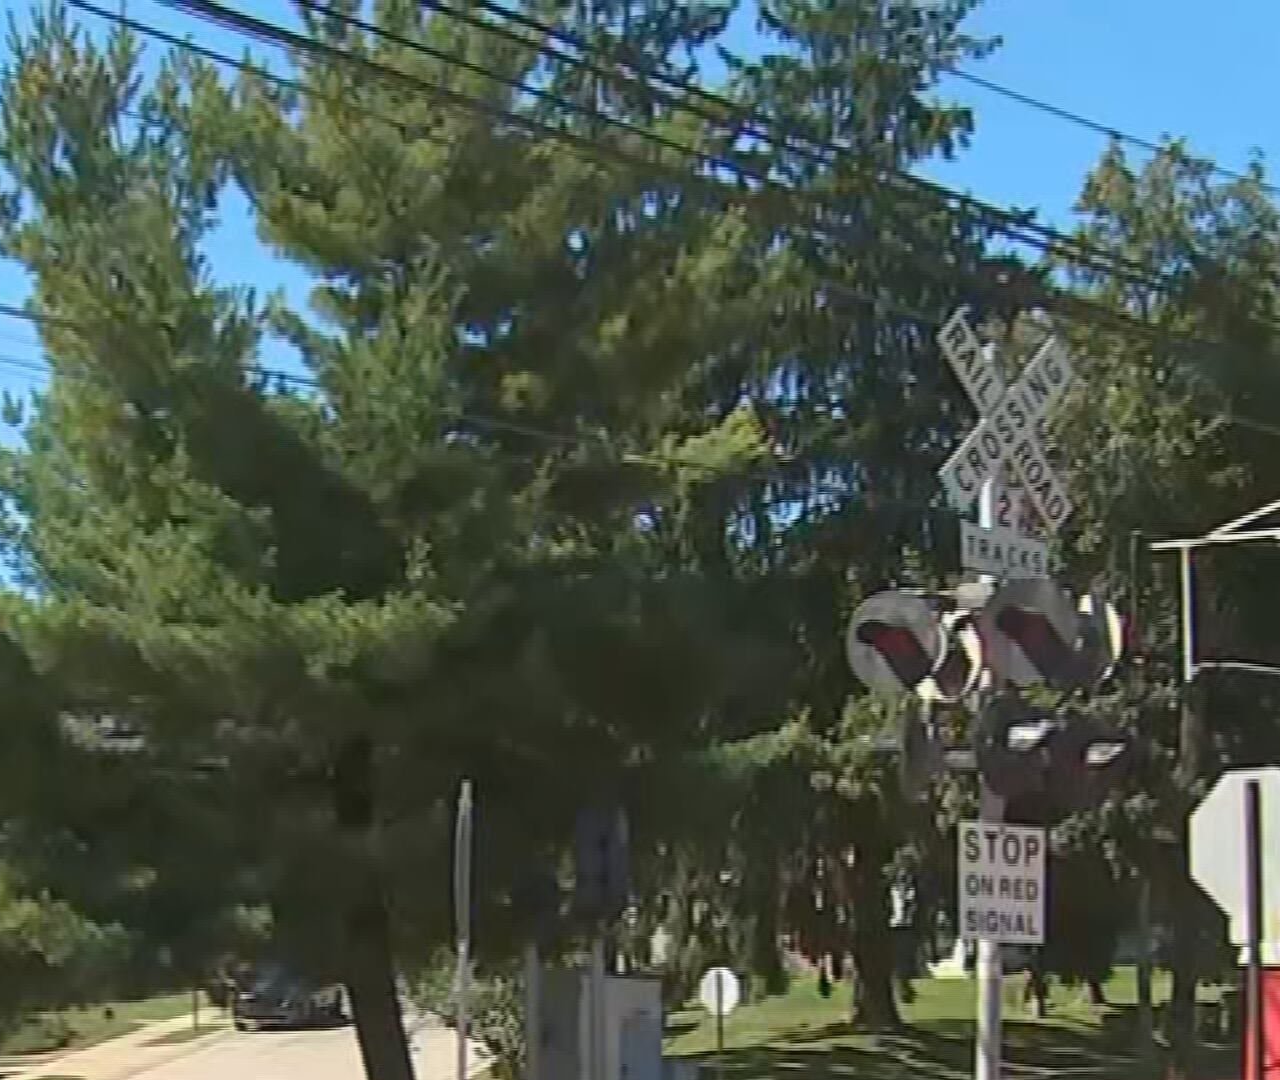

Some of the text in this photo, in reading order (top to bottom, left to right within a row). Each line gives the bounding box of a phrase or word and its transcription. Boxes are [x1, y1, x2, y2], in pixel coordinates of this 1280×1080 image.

[946, 322, 993, 406] RAIL
[954, 357, 1064, 491] CROSSING
[967, 535, 1042, 576] TRACKS
[965, 828, 1040, 868] STOP
[965, 873, 1039, 903] ON RED
[966, 909, 1041, 936] SIGNAL
